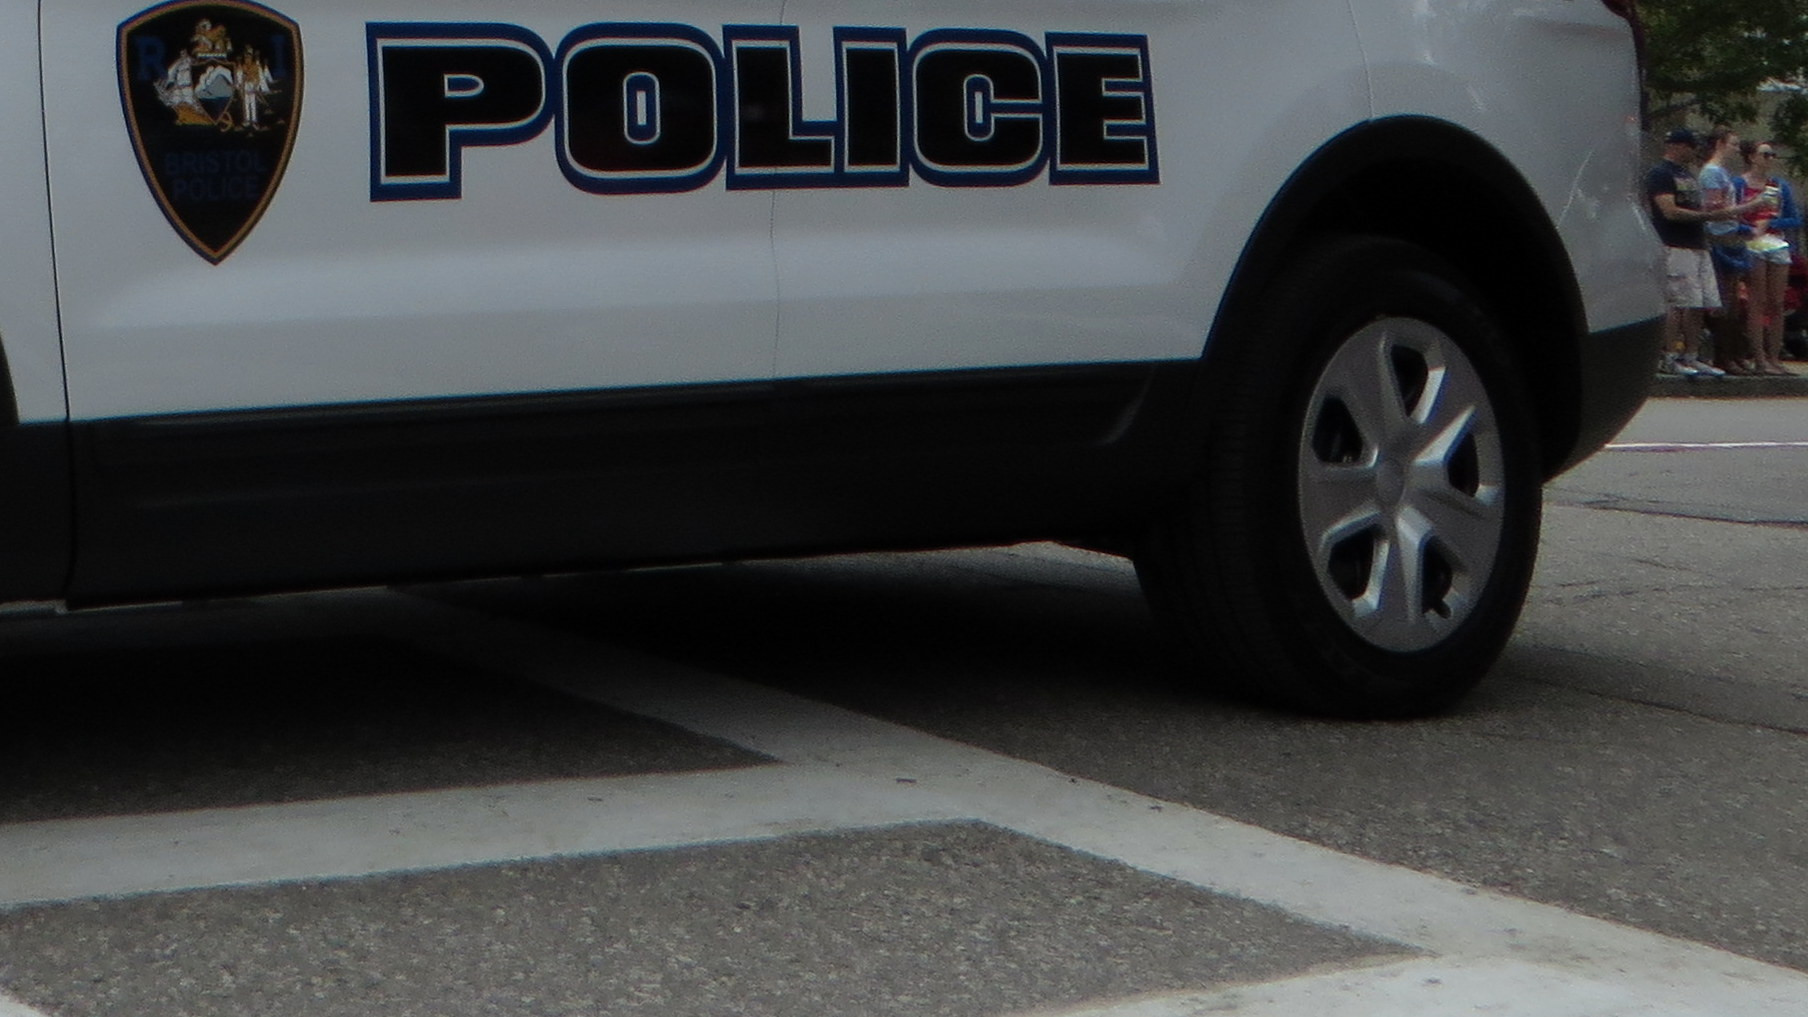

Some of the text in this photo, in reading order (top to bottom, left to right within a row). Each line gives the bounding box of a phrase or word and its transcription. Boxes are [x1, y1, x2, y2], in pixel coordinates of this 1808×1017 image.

[365, 22, 1161, 201] POLICE
[165, 150, 267, 175] BRISTOL
[173, 176, 260, 201] POLICE
